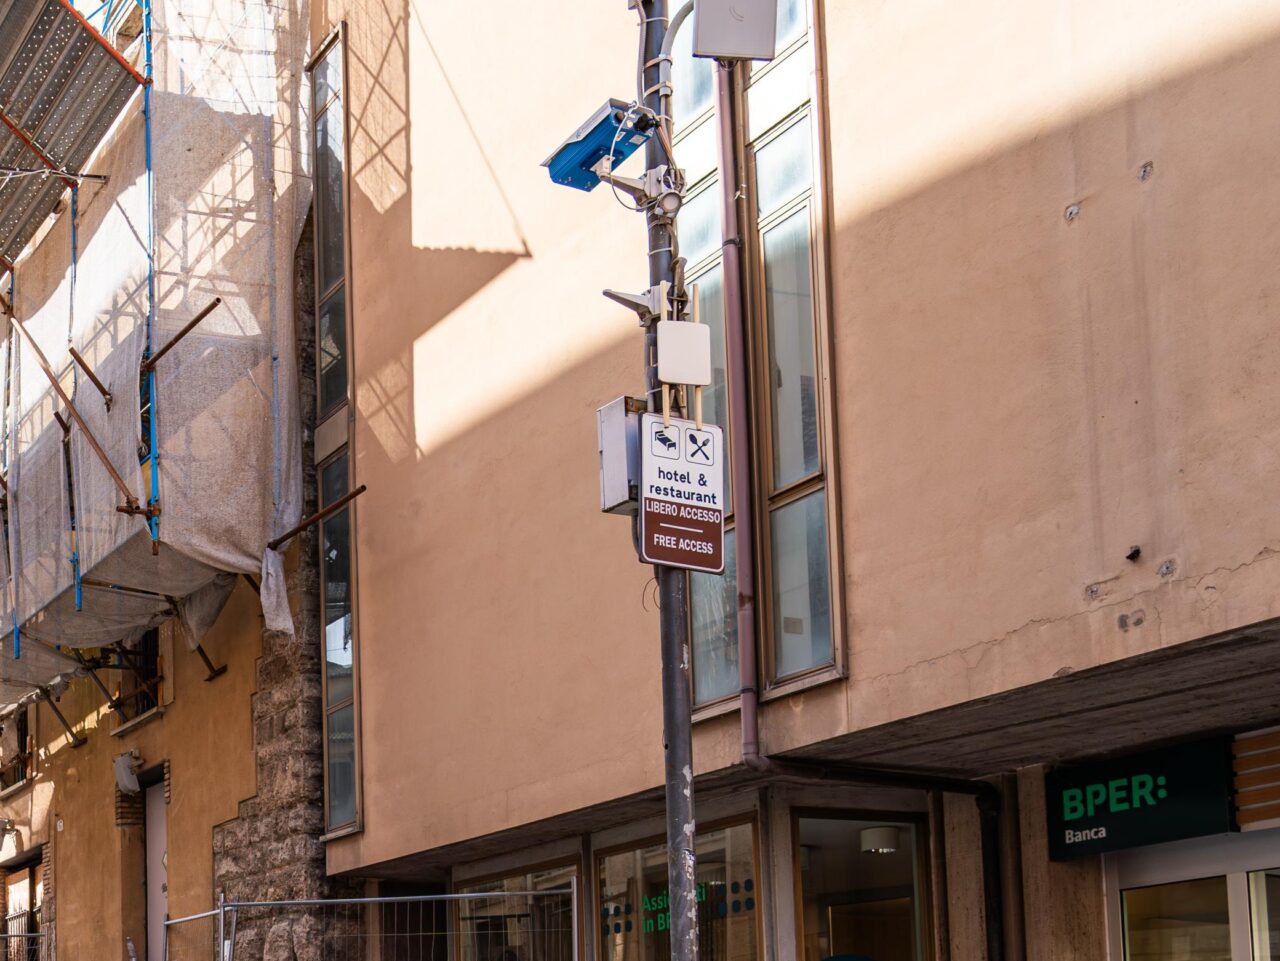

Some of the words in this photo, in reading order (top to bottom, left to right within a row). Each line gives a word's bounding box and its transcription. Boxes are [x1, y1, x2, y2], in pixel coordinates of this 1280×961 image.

[658, 467, 691, 485] hotel
[698, 473, 708, 487] &
[650, 483, 717, 505] restaurant
[646, 499, 678, 517] LIBERO
[679, 505, 721, 524] ACCESSO
[653, 533, 677, 549] FREE
[678, 537, 714, 555] ACCESS
[1064, 827, 1107, 844] Banca
[641, 883, 706, 912] Assiti
